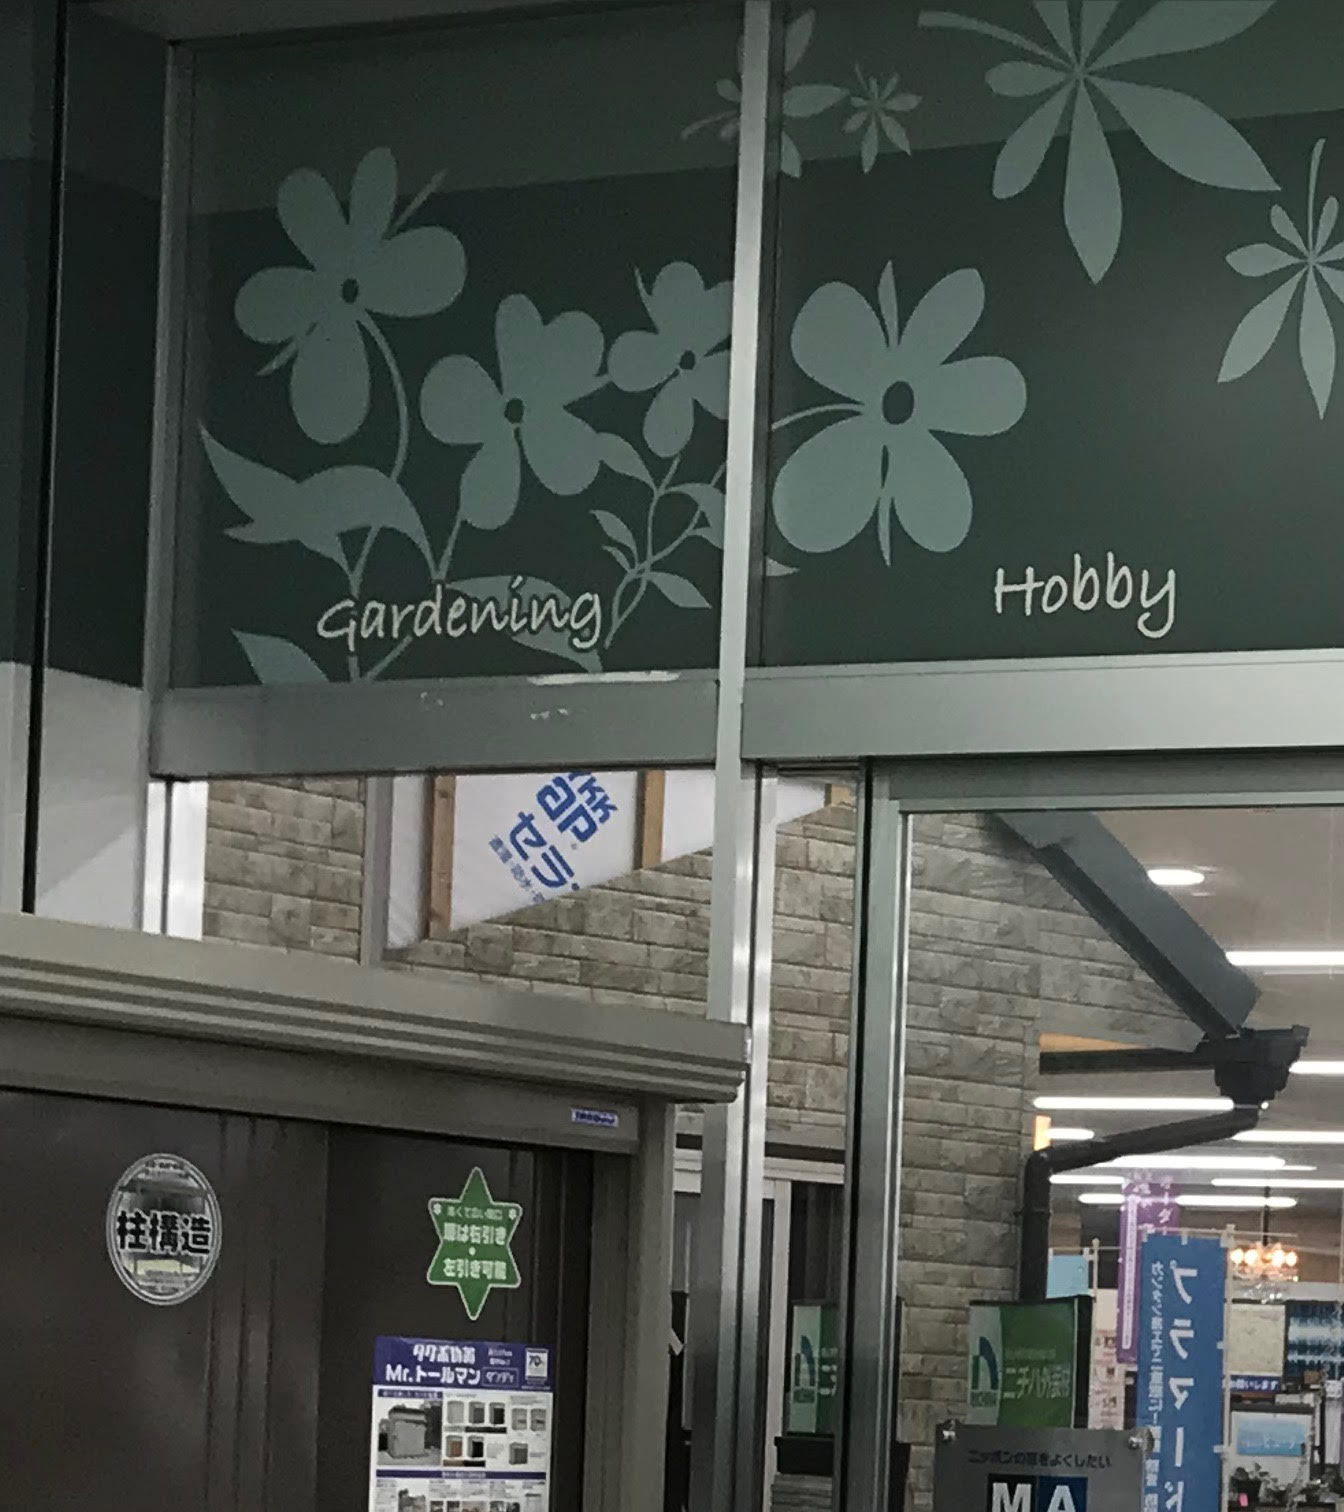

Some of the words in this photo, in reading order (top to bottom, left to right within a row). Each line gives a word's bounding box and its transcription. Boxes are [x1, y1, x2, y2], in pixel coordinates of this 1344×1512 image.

[315, 575, 603, 650] Gardening
[994, 552, 1178, 638] Hobby
[116, 1210, 213, 1255] 柱構造
[384, 1363, 482, 1385] Mr.トールマン
